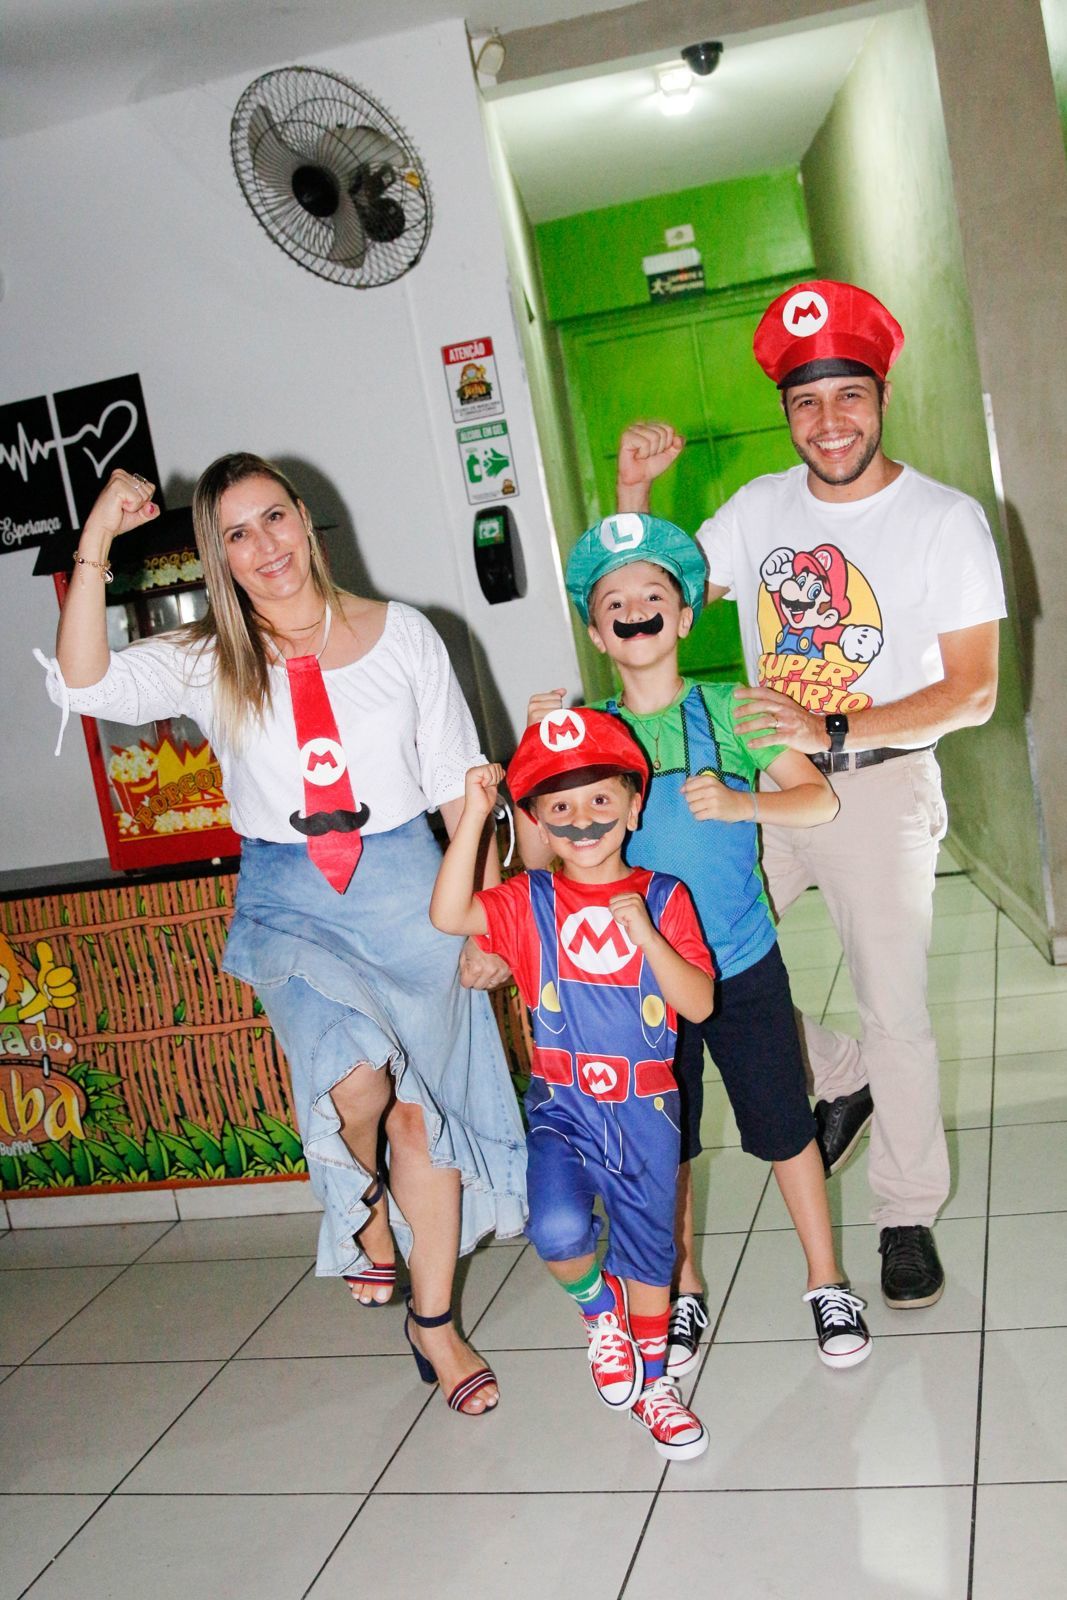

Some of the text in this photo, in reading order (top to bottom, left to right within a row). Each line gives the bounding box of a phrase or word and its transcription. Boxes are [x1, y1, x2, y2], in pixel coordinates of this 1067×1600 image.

[792, 301, 821, 324] M
[449, 341, 485, 362] ATENÇÃO
[610, 520, 633, 545] L
[816, 551, 829, 570] M
[758, 654, 857, 690] SUPER
[548, 715, 580, 745] M
[307, 750, 338, 771] M
[568, 917, 631, 958] M
[586, 1066, 613, 1087] M
